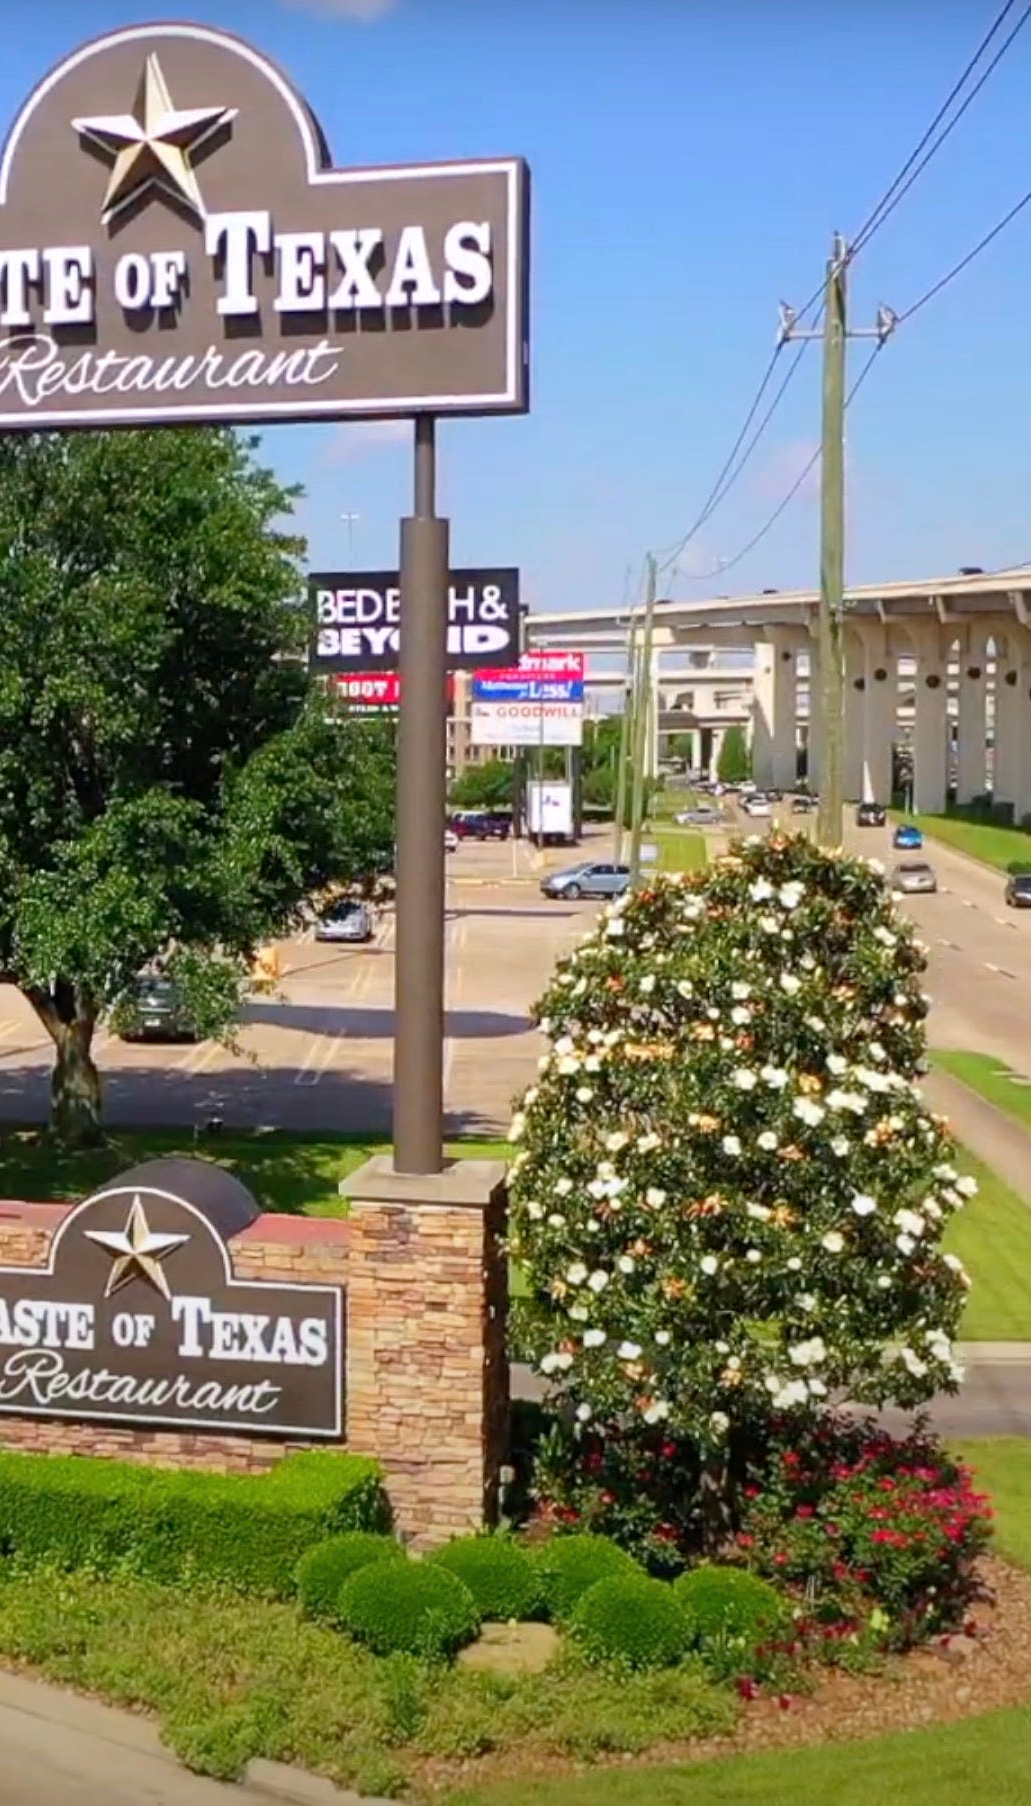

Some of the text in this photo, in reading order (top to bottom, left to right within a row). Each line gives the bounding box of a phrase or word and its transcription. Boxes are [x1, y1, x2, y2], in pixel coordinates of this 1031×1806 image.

[114, 250, 188, 311] OF
[205, 210, 493, 315] TEXAS
[317, 584, 510, 624] BED BH &
[316, 624, 511, 656] BEYD
[496, 705, 579, 718] GOODWILL
[112, 1312, 154, 1347] OF
[172, 1297, 329, 1366] TEXAS
